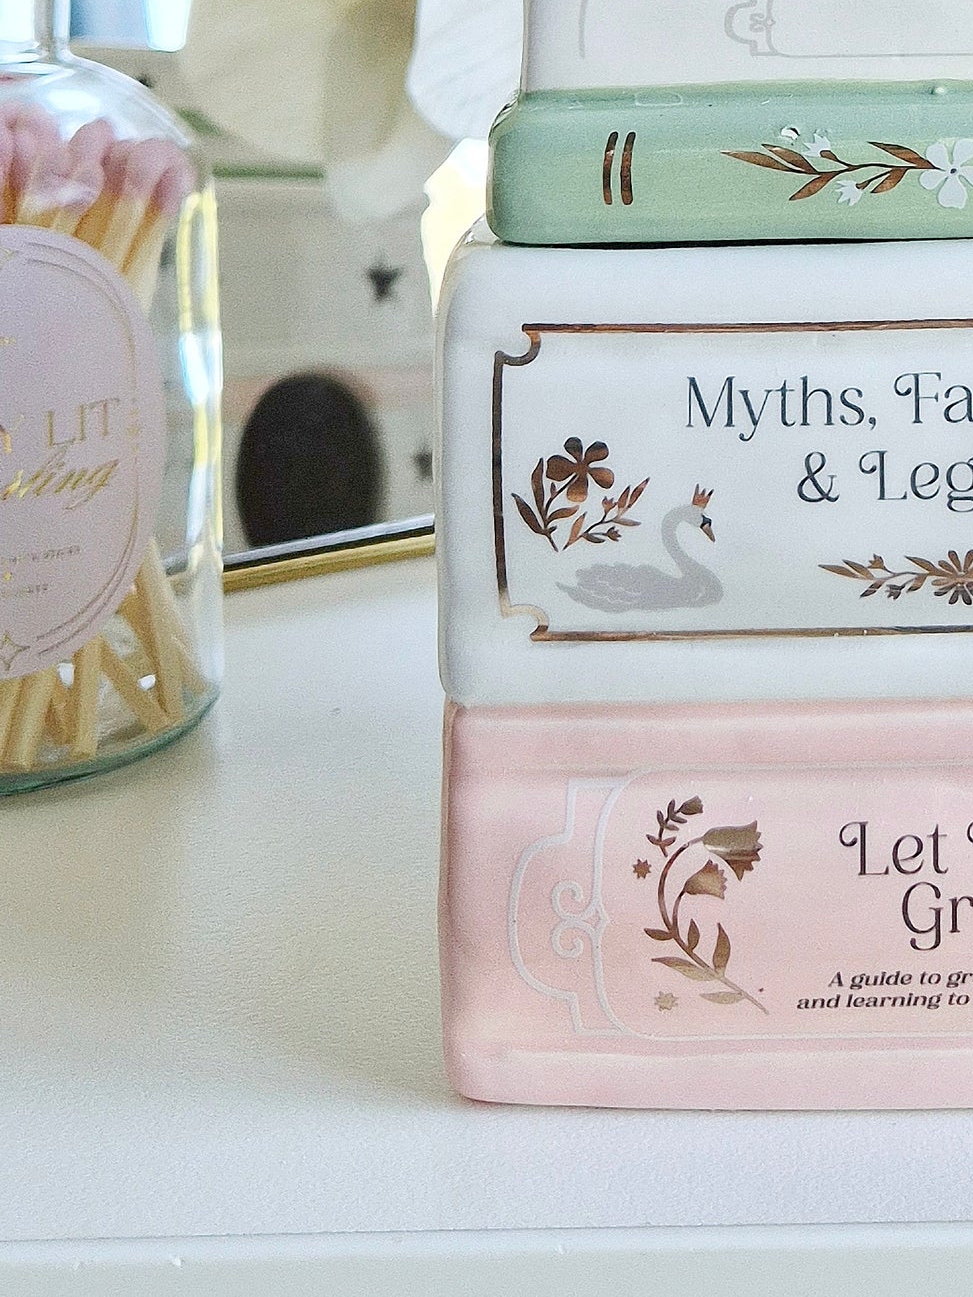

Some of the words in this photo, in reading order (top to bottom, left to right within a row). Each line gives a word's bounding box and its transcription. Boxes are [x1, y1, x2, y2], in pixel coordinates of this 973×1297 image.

[46, 397, 120, 446] LIT
[685, 374, 877, 442] Myths,
[796, 451, 840, 503] &
[838, 820, 949, 876] Let
[796, 993, 841, 1010] and
[845, 992, 943, 1011] learning
[948, 992, 971, 1006] to
[827, 971, 844, 988] A
[849, 970, 913, 991] guide
[919, 970, 942, 986] to
